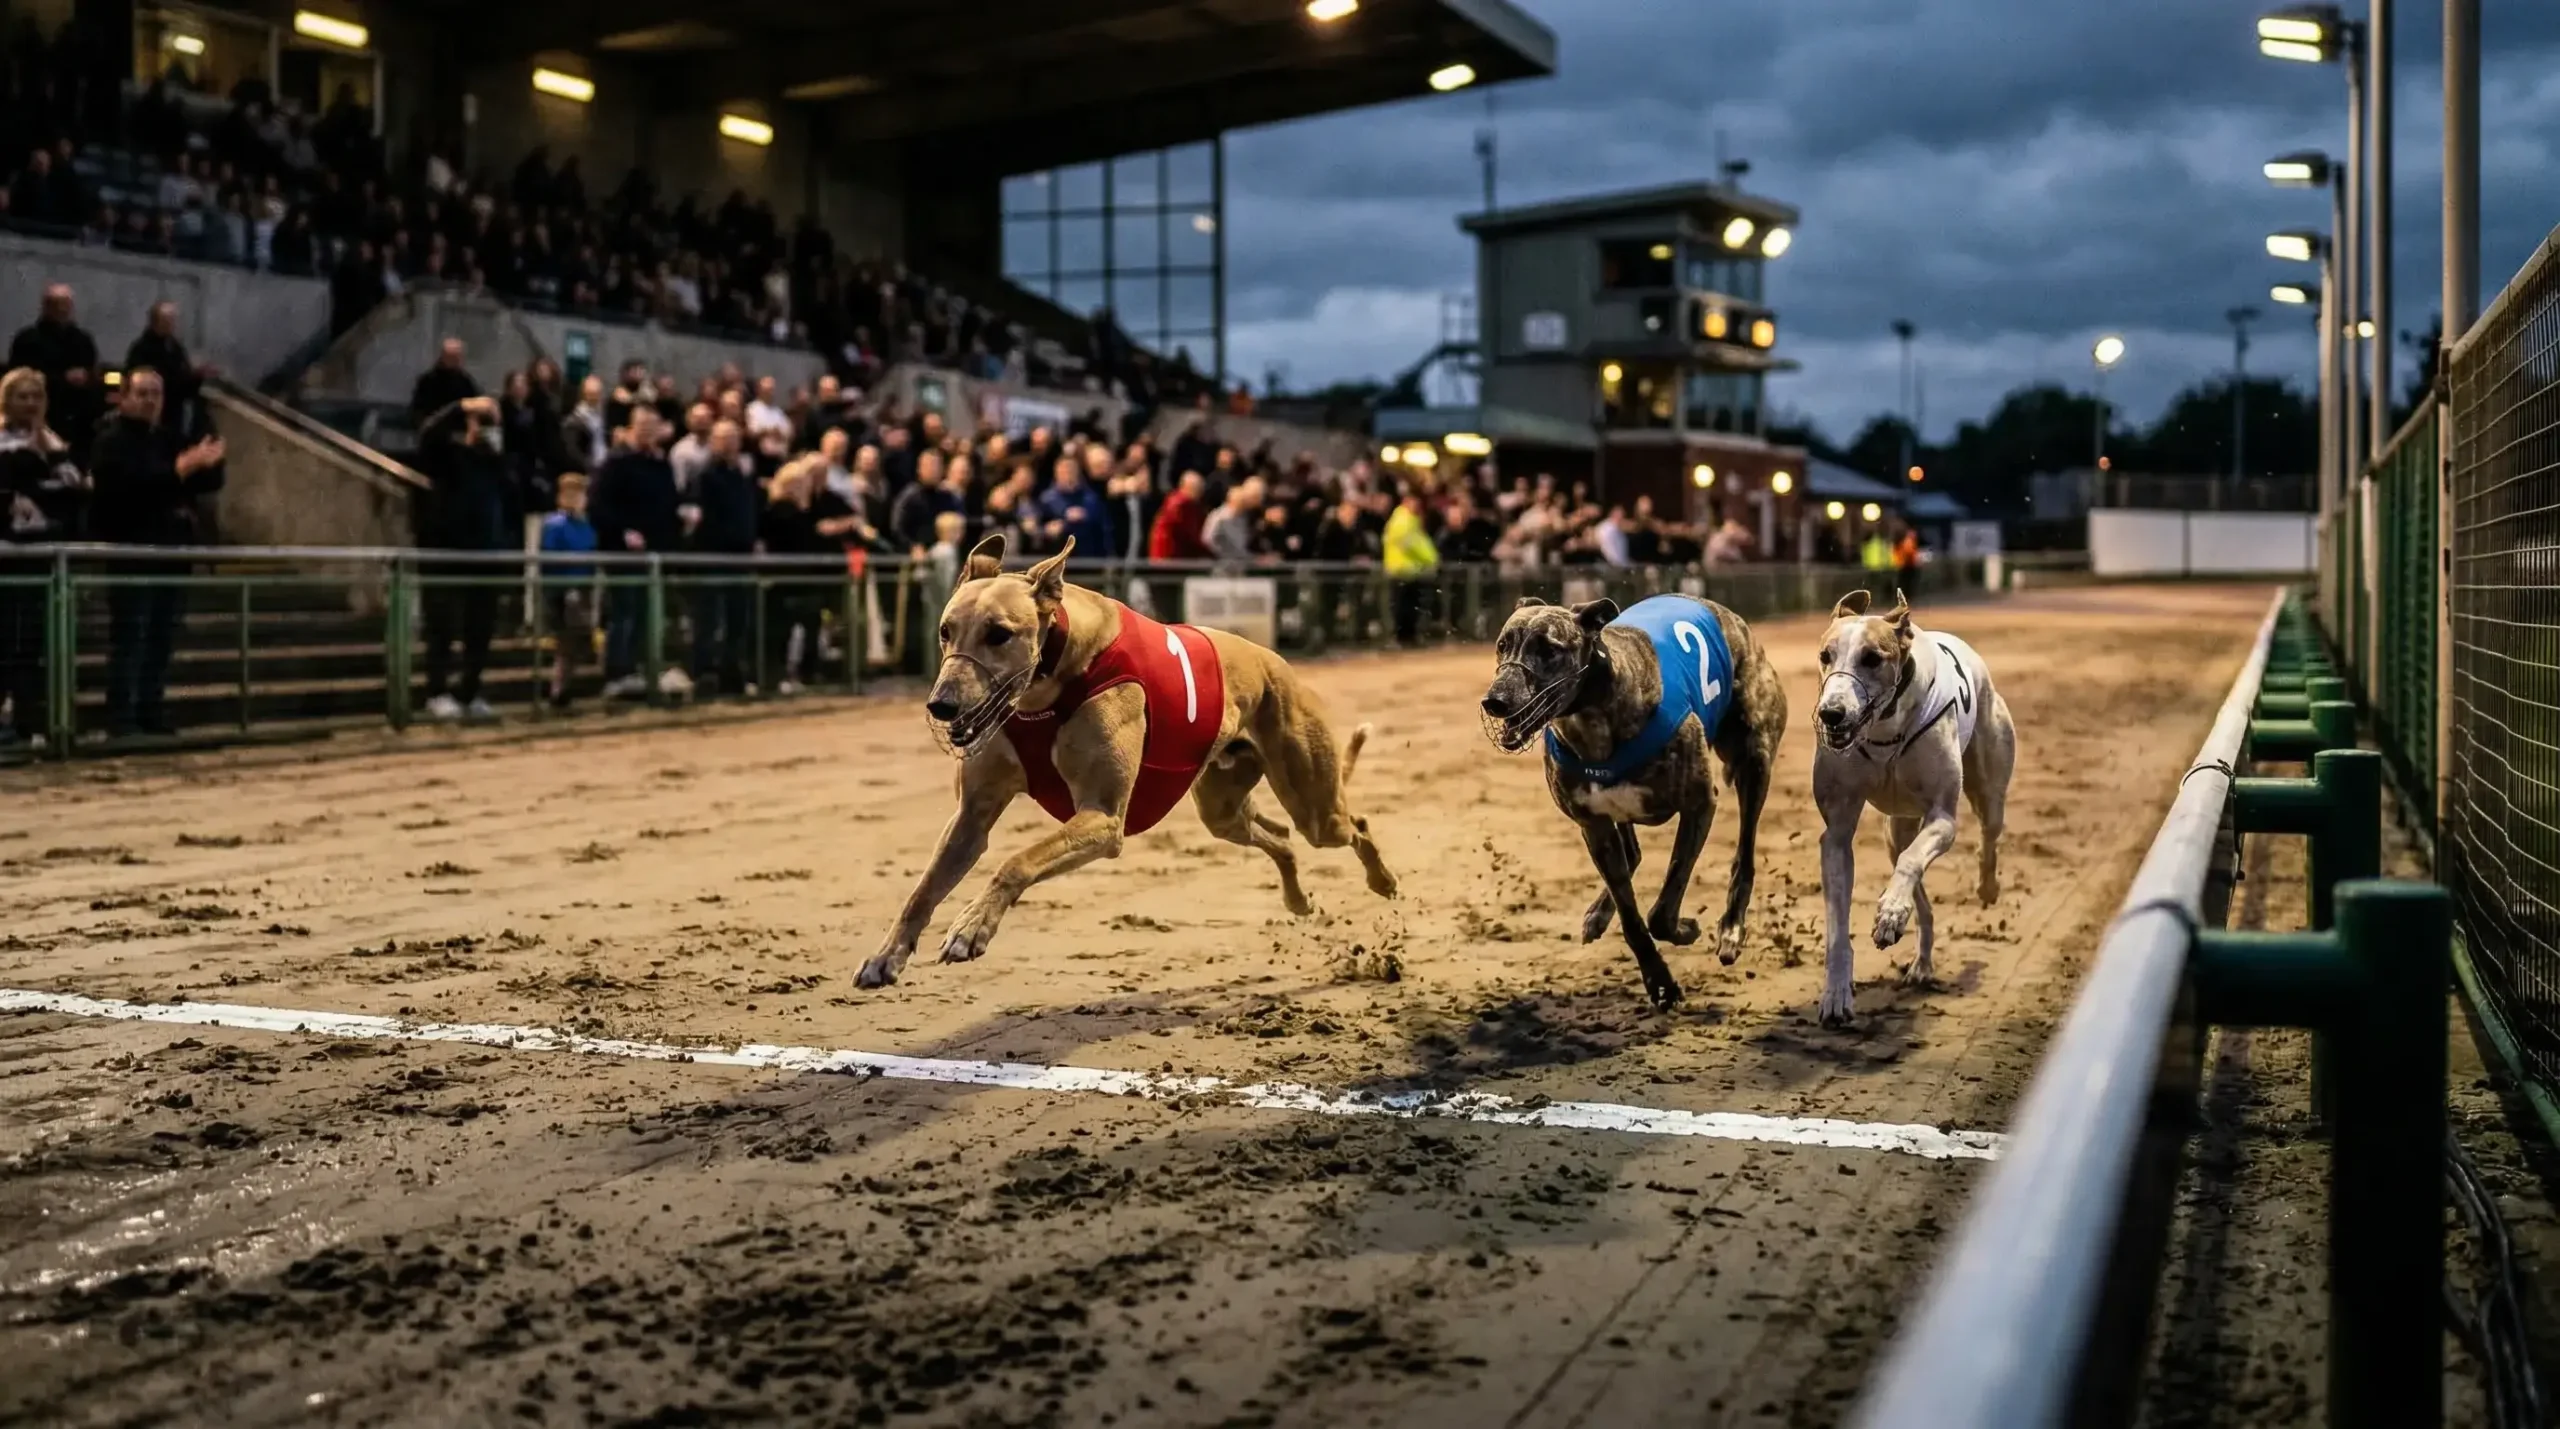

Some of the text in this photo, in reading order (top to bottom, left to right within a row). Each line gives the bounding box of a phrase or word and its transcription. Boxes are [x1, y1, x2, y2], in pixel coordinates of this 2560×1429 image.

[1165, 627, 1197, 724] 1
[1673, 621, 1721, 706] 2
[1937, 642, 1971, 715] 3
